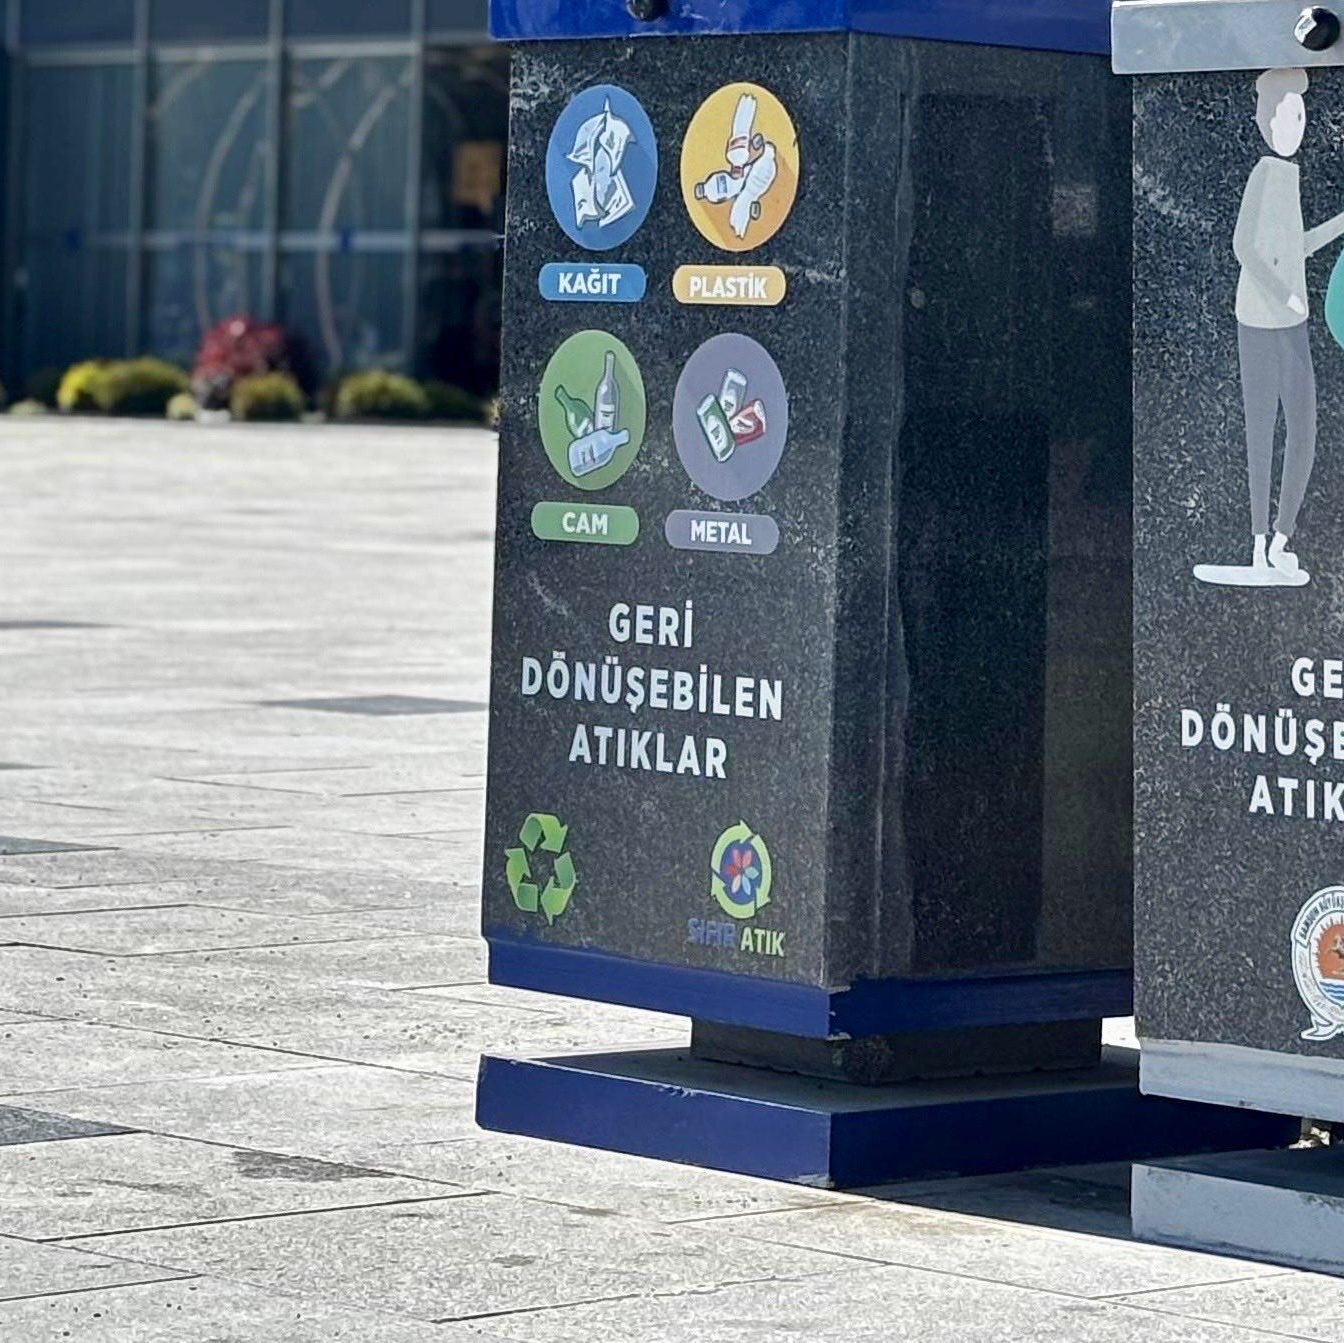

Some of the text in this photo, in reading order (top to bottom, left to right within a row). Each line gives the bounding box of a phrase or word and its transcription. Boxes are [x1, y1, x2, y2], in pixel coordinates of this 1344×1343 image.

[558, 267, 621, 295] KAĞIT
[689, 271, 768, 299] PLASTİK
[562, 513, 609, 536] CAM
[690, 521, 752, 546] METAL
[609, 600, 693, 648] GERİ
[521, 651, 783, 720] DÖNÜŞEBİLEN
[568, 724, 727, 779] ATIKLAR
[740, 926, 785, 957] ATIK
